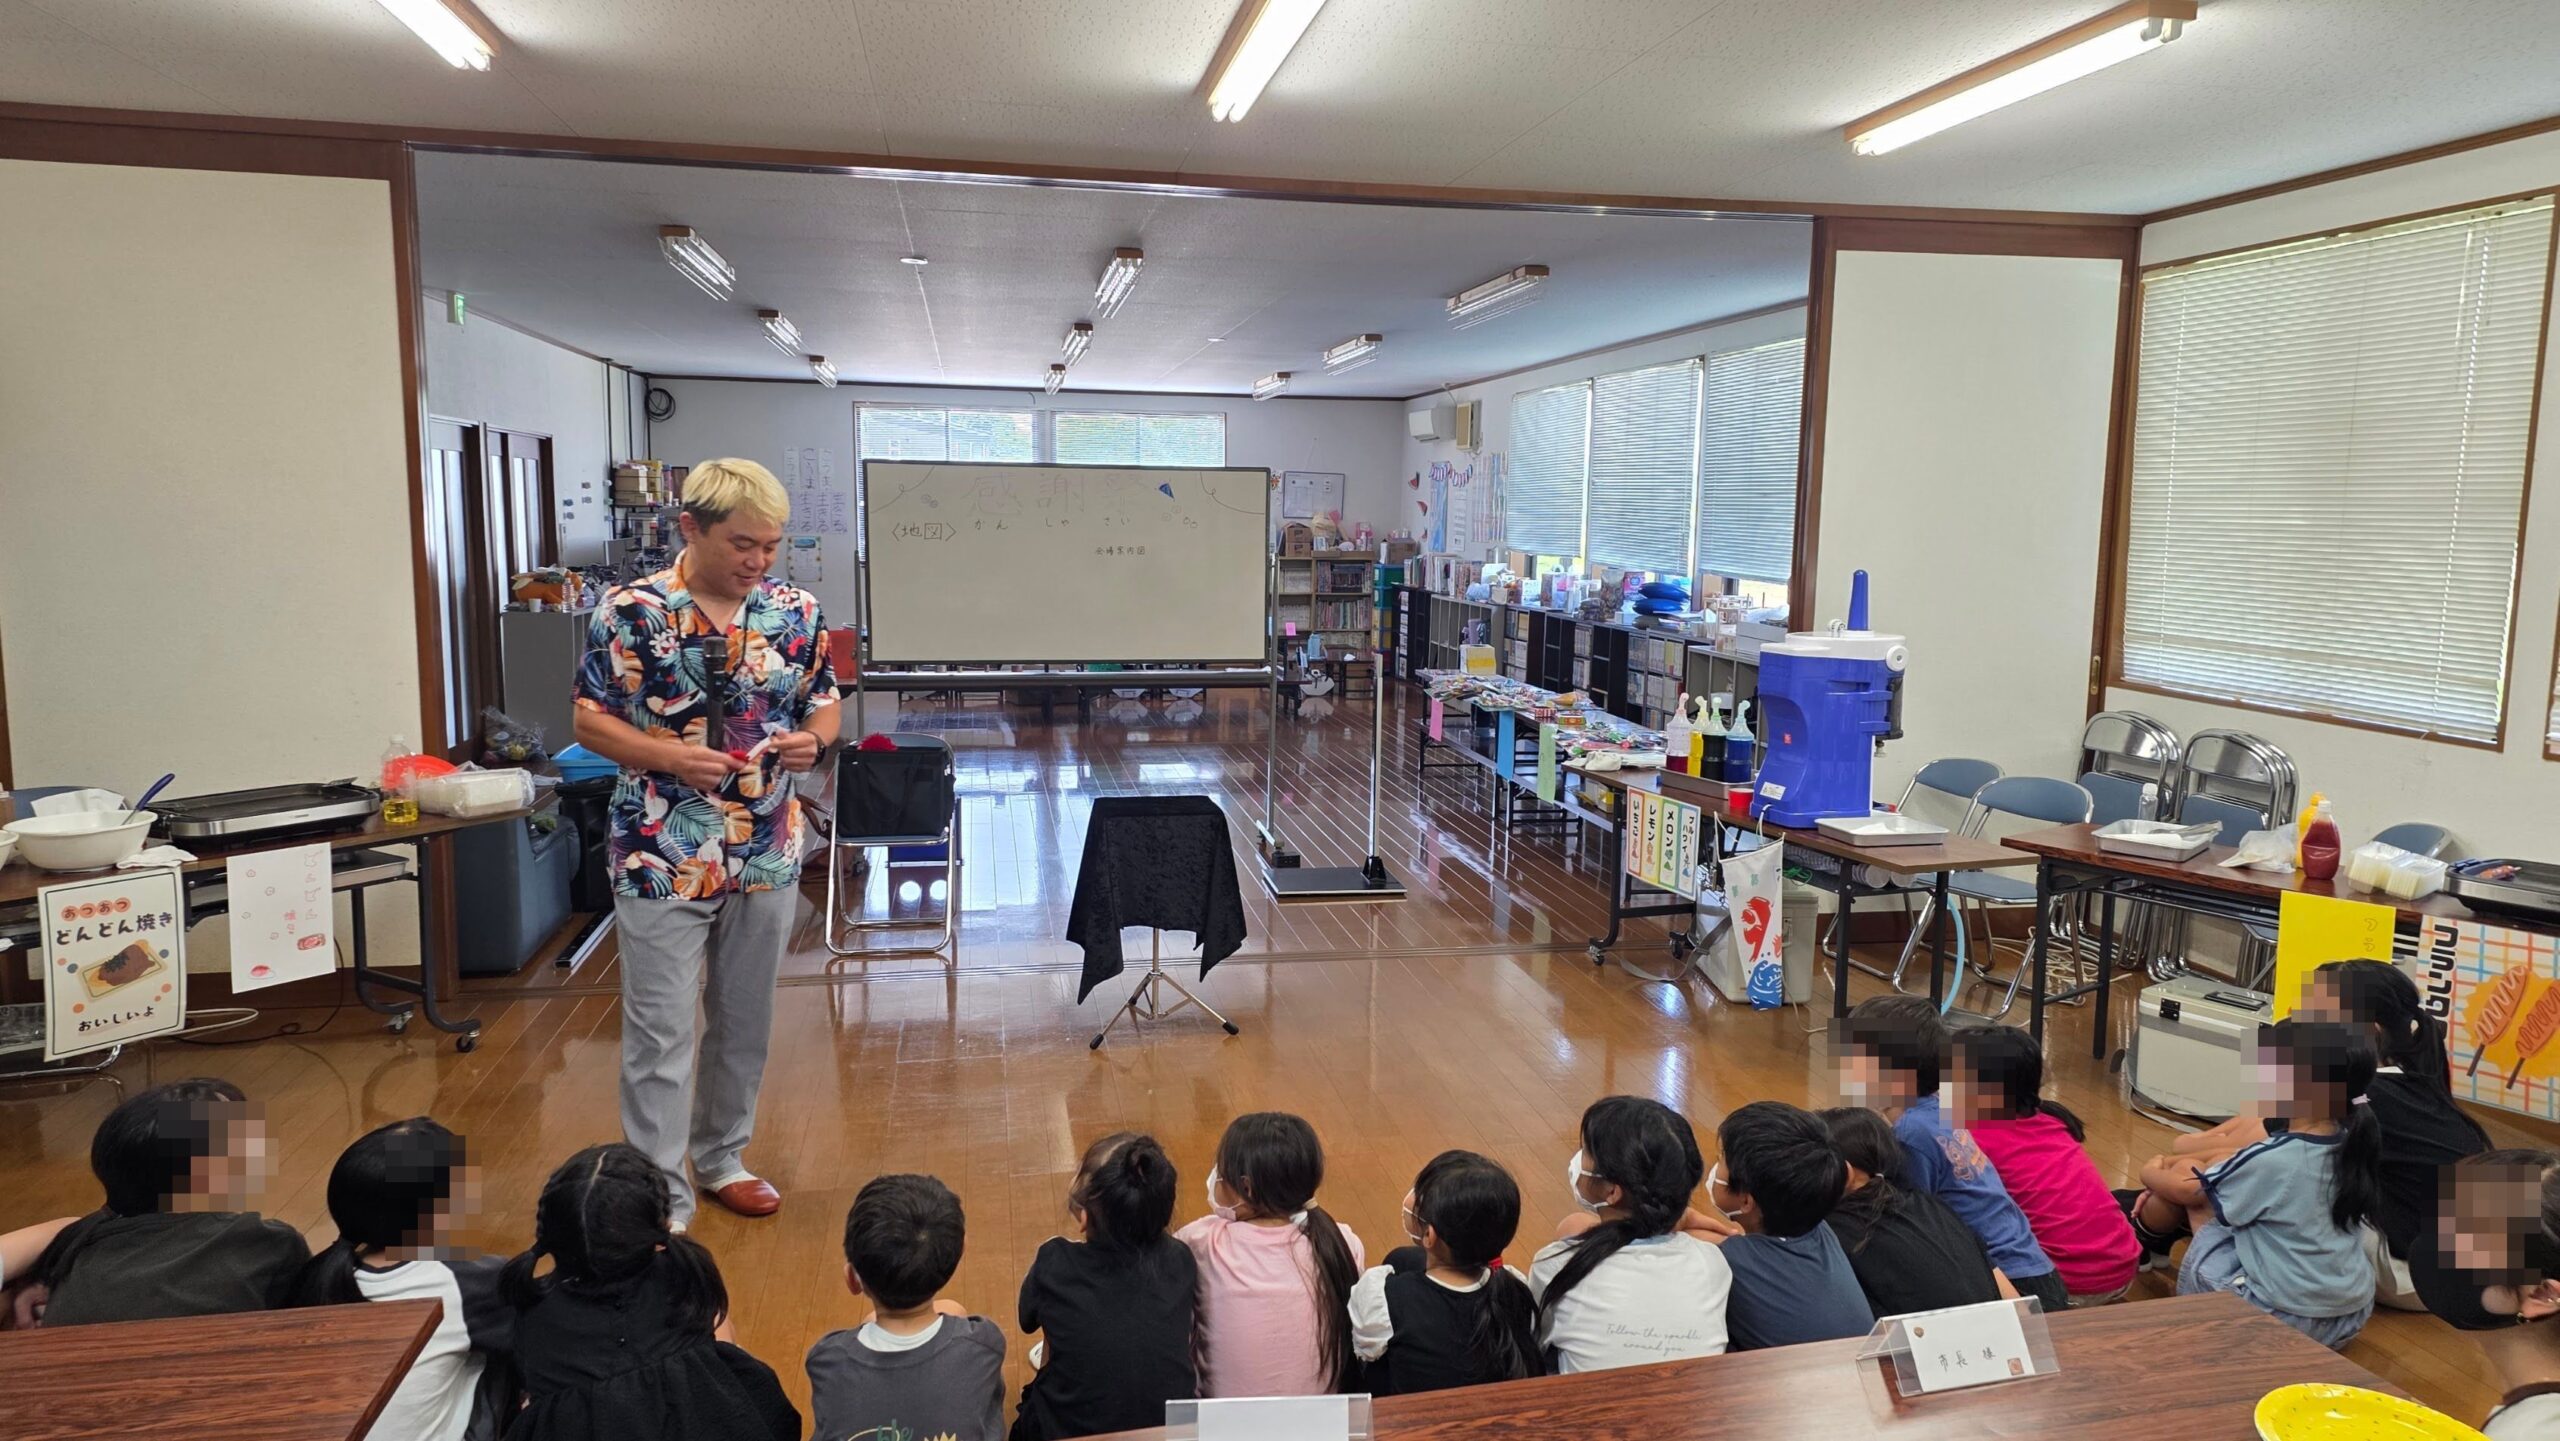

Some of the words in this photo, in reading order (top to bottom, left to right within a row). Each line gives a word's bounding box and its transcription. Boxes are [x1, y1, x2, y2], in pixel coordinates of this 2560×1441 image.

[1648, 804, 1657, 841] レモン
[1666, 811, 1674, 847] メロン
[62, 899, 129, 921] あつあつ
[56, 911, 173, 946] どんどん焼き
[78, 1006, 154, 1032] おいしいよ
